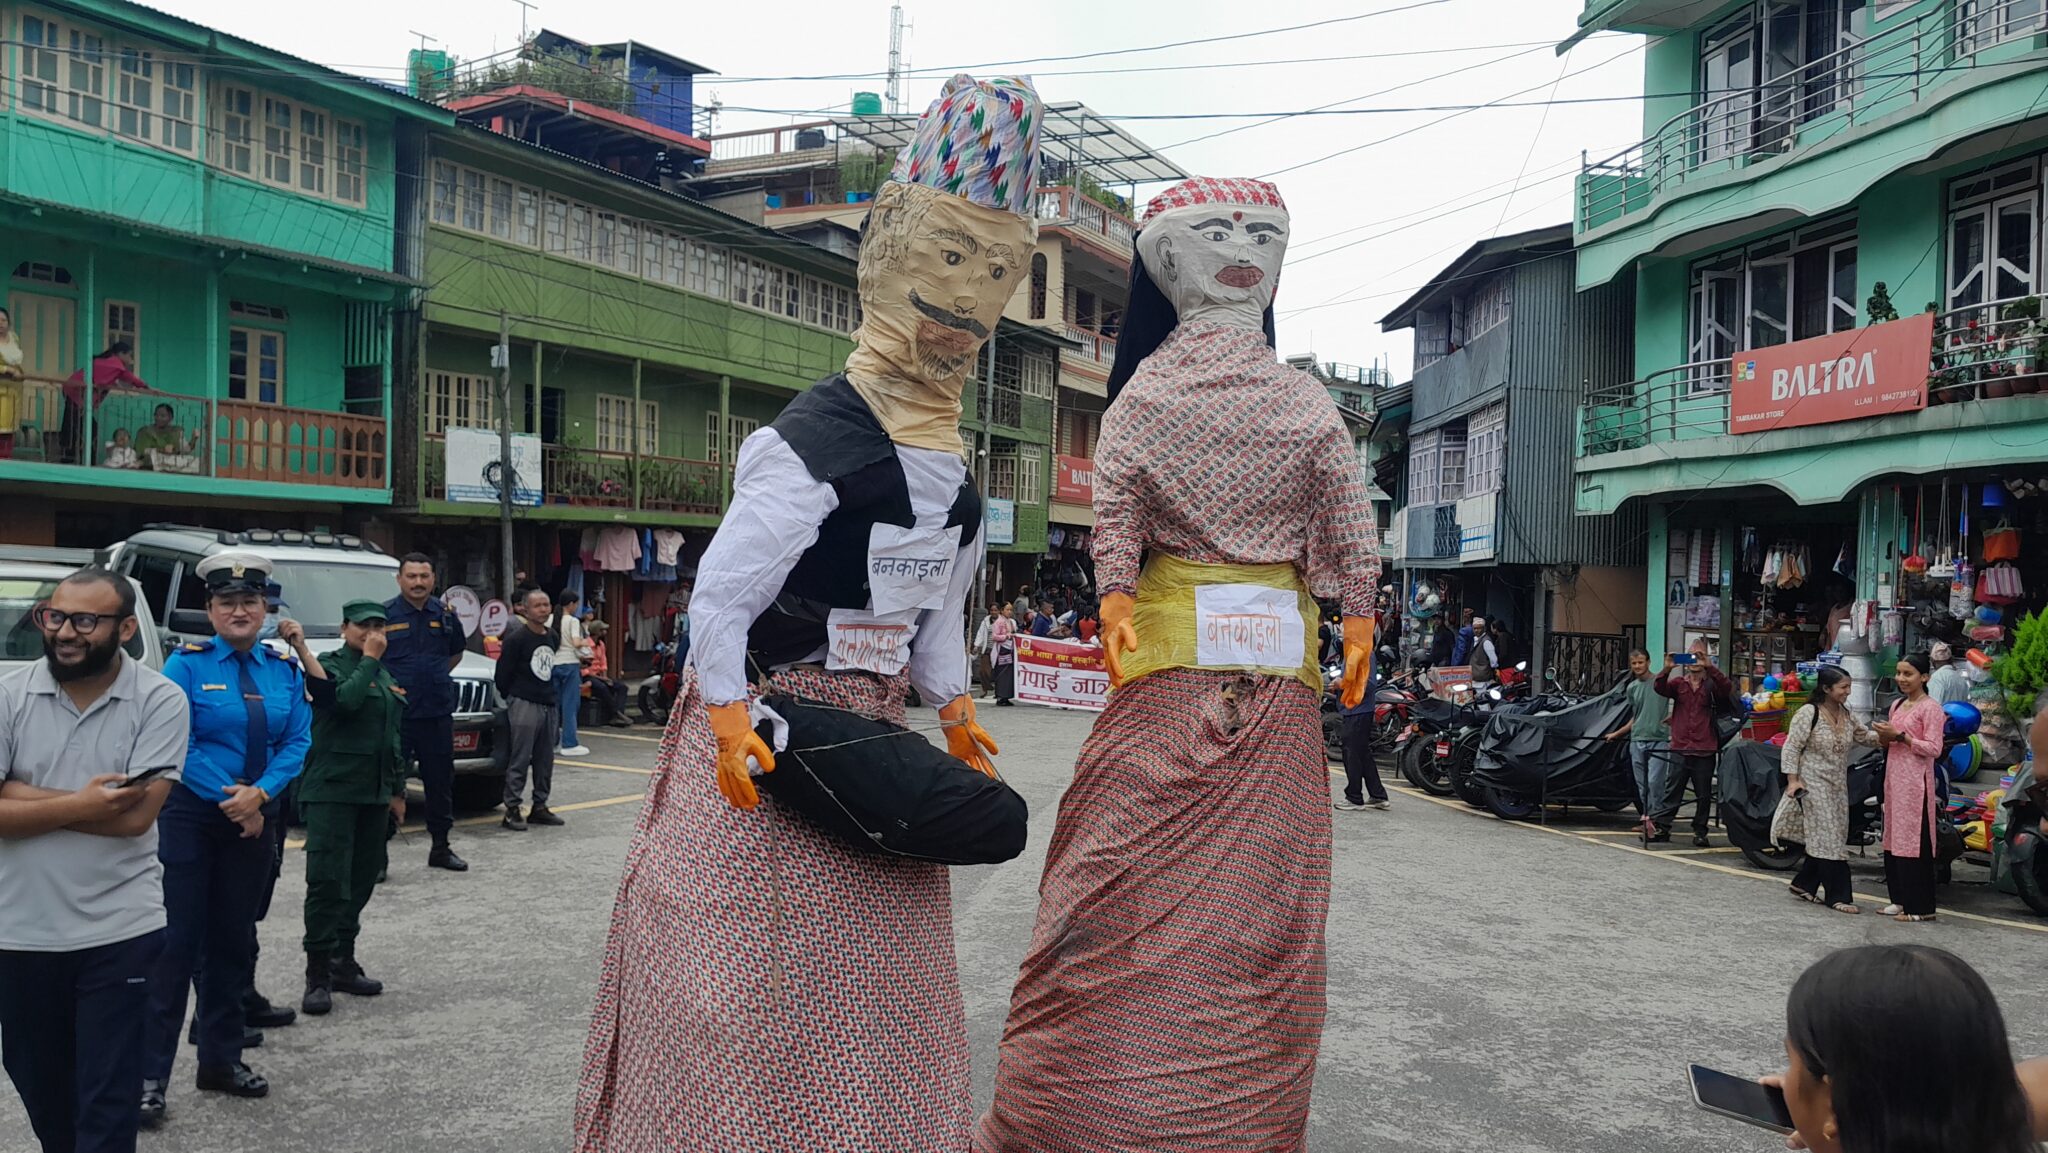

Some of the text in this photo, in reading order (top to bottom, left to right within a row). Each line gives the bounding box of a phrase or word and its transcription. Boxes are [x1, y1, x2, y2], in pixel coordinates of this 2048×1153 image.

[1771, 352, 1875, 400] BALTRA
[1854, 396, 1873, 406] ILLAM
[1735, 409, 1785, 422] TAMRAKAR STORE
[489, 606, 500, 618] P
